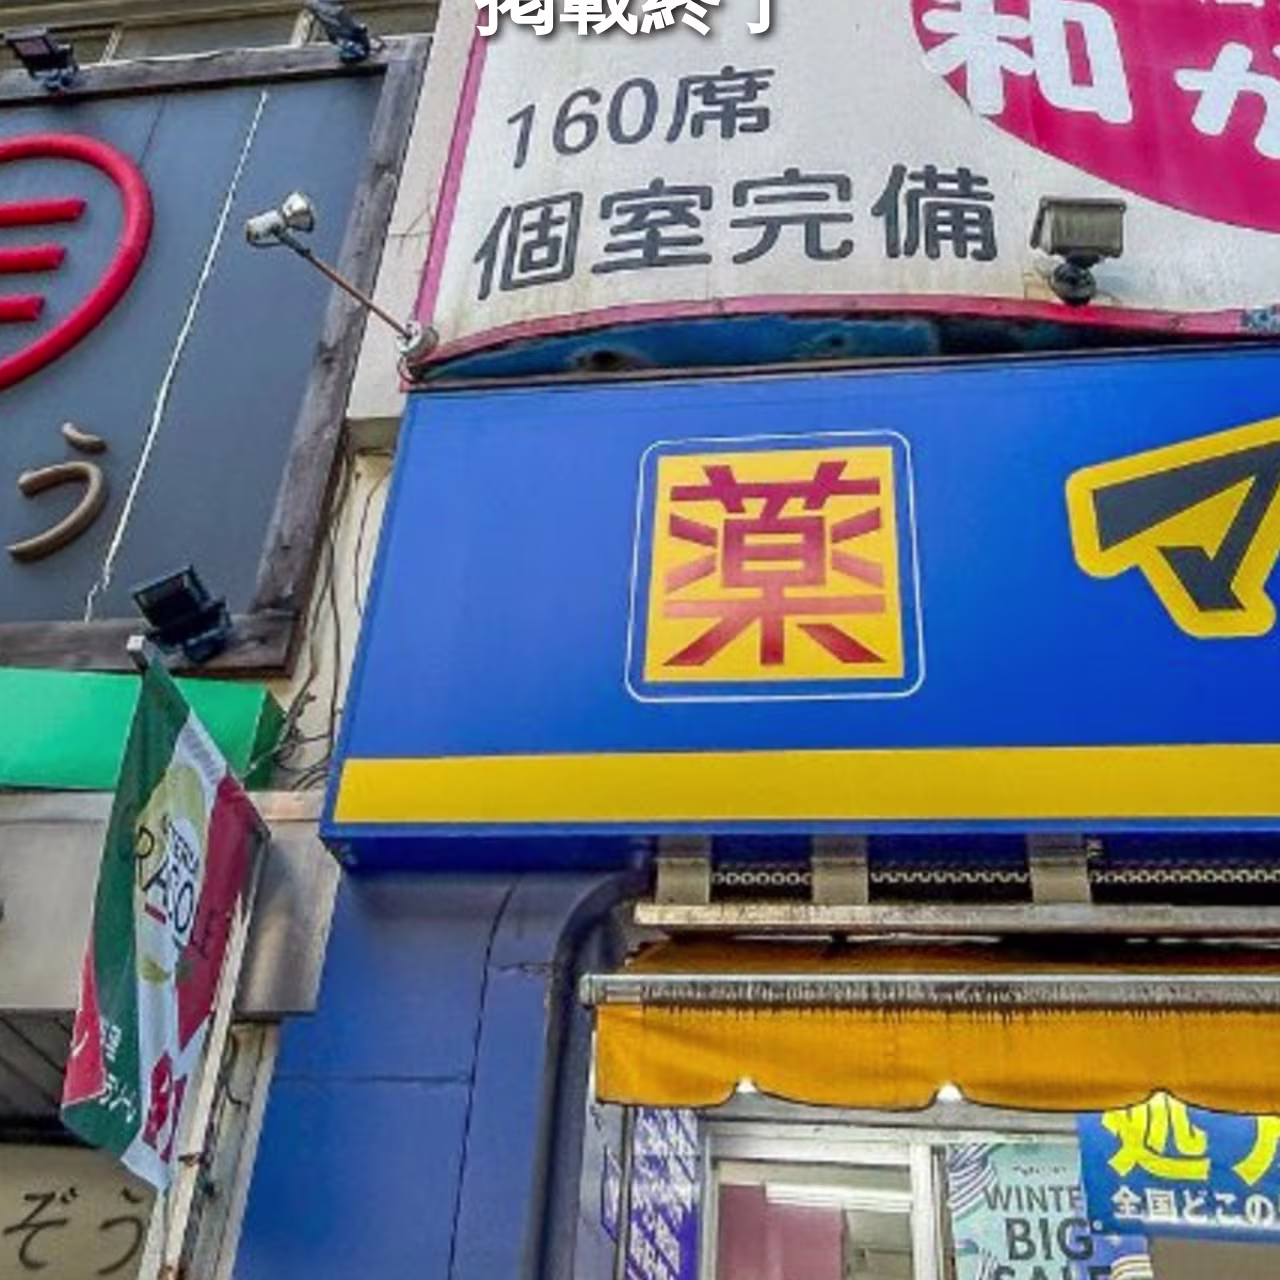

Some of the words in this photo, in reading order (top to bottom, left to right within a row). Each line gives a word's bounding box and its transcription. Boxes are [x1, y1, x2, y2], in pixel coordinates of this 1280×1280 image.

[506, 65, 776, 168] 160席
[472, 163, 998, 302] 個室完備
[662, 460, 887, 667] 薬
[1006, 1218, 1094, 1260] BIG
